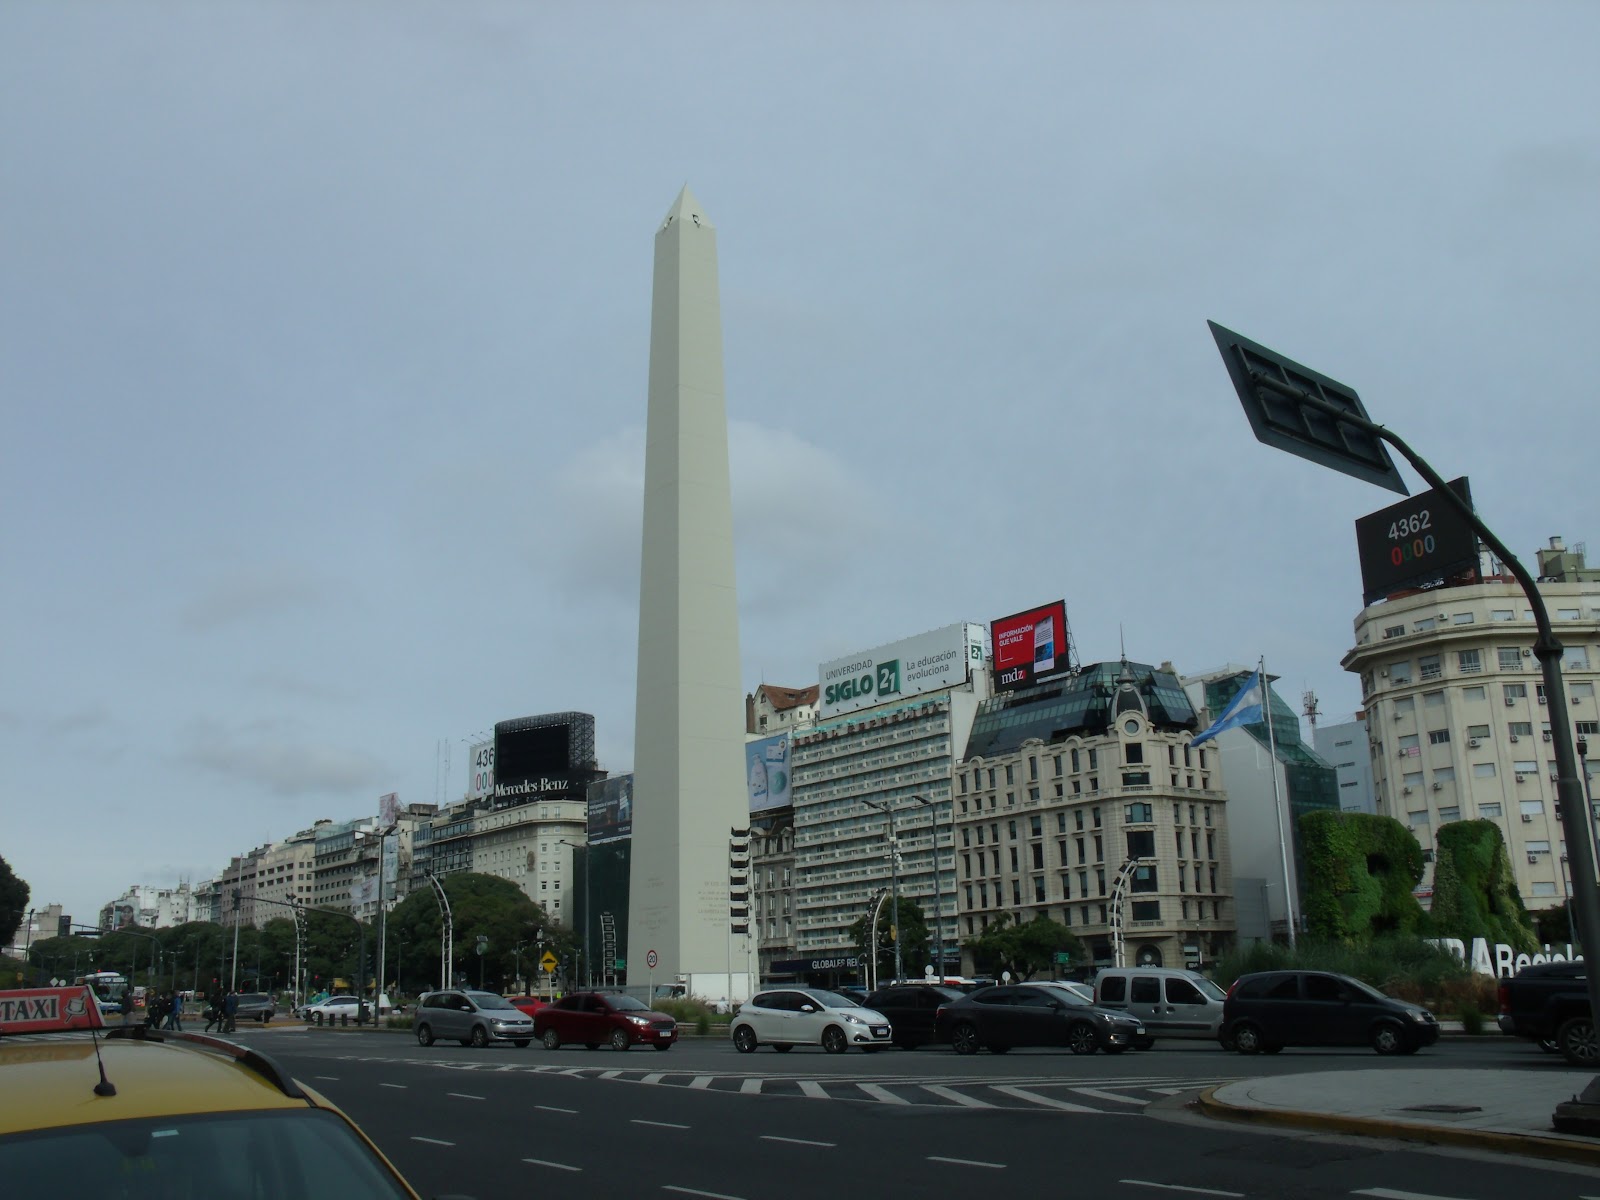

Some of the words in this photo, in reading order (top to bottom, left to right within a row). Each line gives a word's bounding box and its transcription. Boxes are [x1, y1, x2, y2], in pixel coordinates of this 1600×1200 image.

[1388, 510, 1431, 540] 4362
[1391, 535, 1435, 566] 0000
[999, 624, 1033, 639] INFORMACIÓN
[1010, 634, 1023, 643] VALE
[825, 659, 873, 681] UNIVERSIDAD
[906, 661, 916, 671] La
[917, 649, 957, 668] educación
[907, 663, 950, 682] evoluciona
[1001, 668, 1024, 685] mdz
[825, 674, 874, 705] SIGLO
[879, 668, 896, 693] 21
[495, 777, 569, 798] Mercedes-Benz
[649, 955, 656, 964] 20
[1, 999, 57, 1021] TAXI
